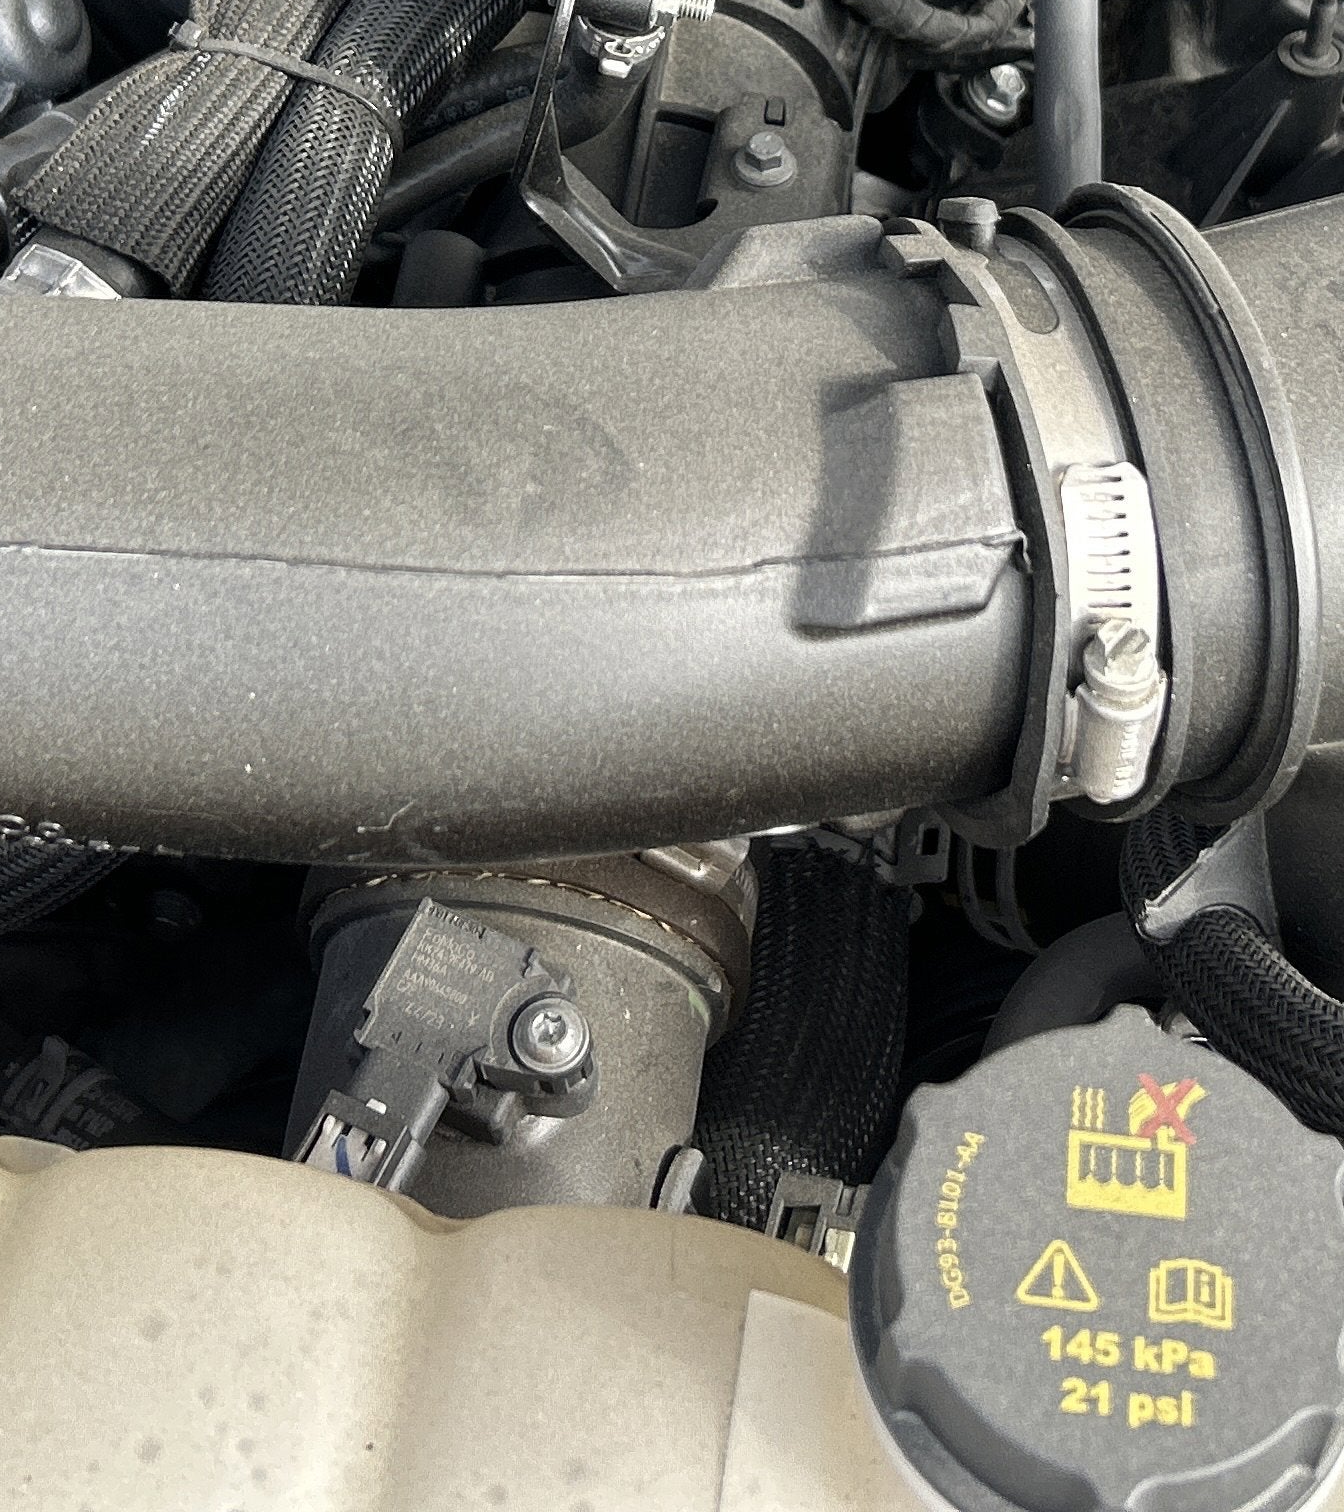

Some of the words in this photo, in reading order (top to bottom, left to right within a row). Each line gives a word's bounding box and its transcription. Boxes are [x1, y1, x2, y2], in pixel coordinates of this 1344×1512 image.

[1041, 1324, 1121, 1367] 145
[1132, 1335, 1217, 1380] kPa
[1060, 1376, 1113, 1417] 21
[1127, 1389, 1196, 1429] psi
